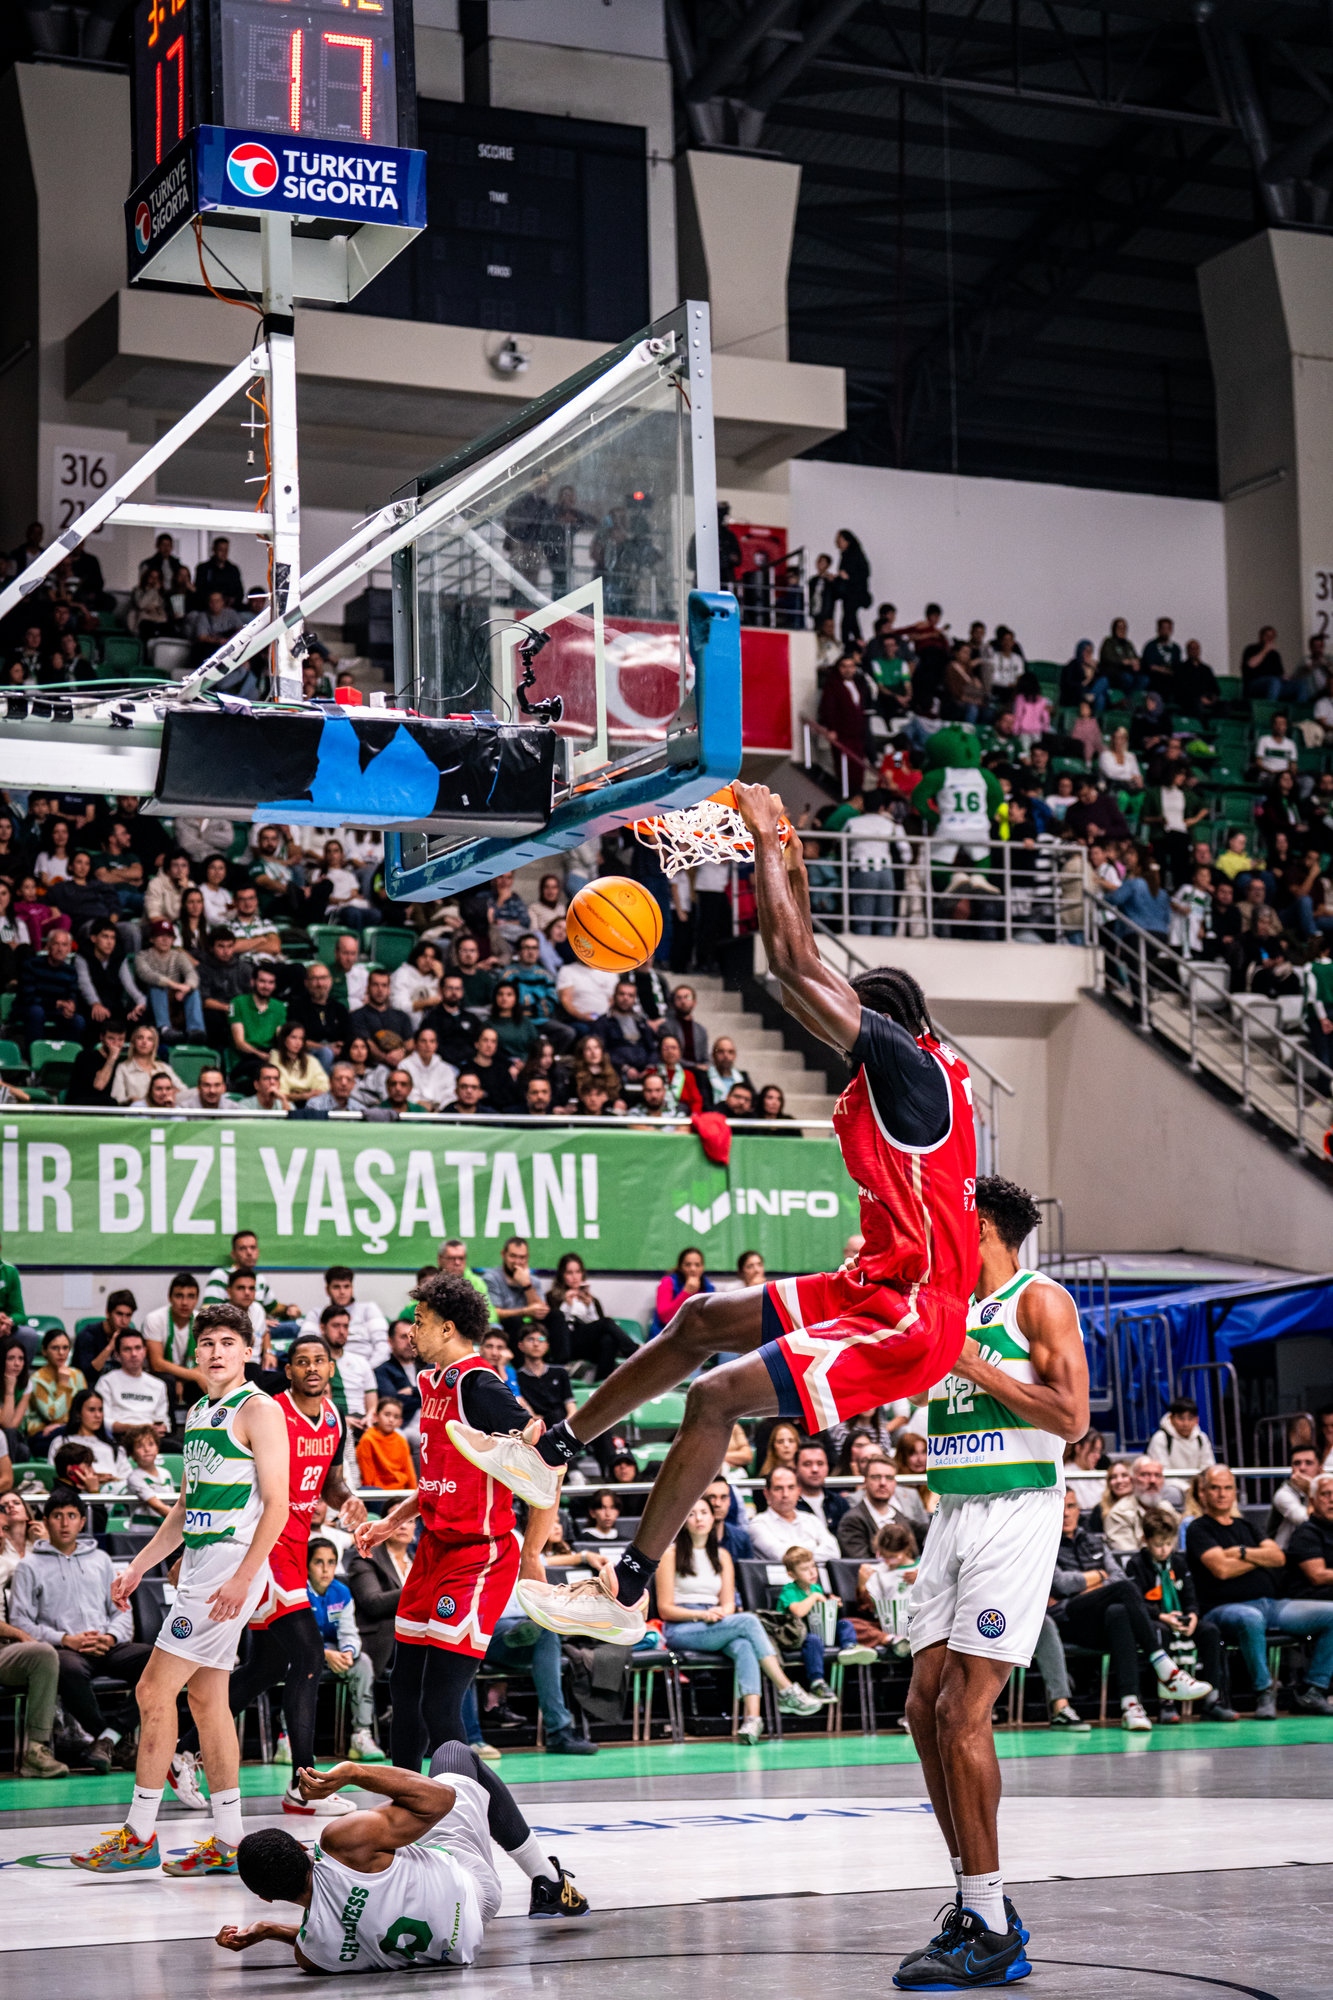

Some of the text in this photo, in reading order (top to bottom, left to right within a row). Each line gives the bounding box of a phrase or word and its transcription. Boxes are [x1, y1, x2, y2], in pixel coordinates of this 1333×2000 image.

[289, 29, 373, 140] 17
[155, 34, 185, 165] 17
[477, 143, 515, 162] SCORE
[60, 453, 108, 489] 316
[953, 791, 980, 813] 16
[98, 1128, 238, 1235] BİZİ
[258, 1147, 601, 1255] YAŞATAN!
[944, 1376, 977, 1415] 12
[296, 1434, 335, 1457] CHOLET
[555, 1440, 573, 1459] 23
[299, 1465, 323, 1491] 23
[622, 1554, 641, 1573] 23
